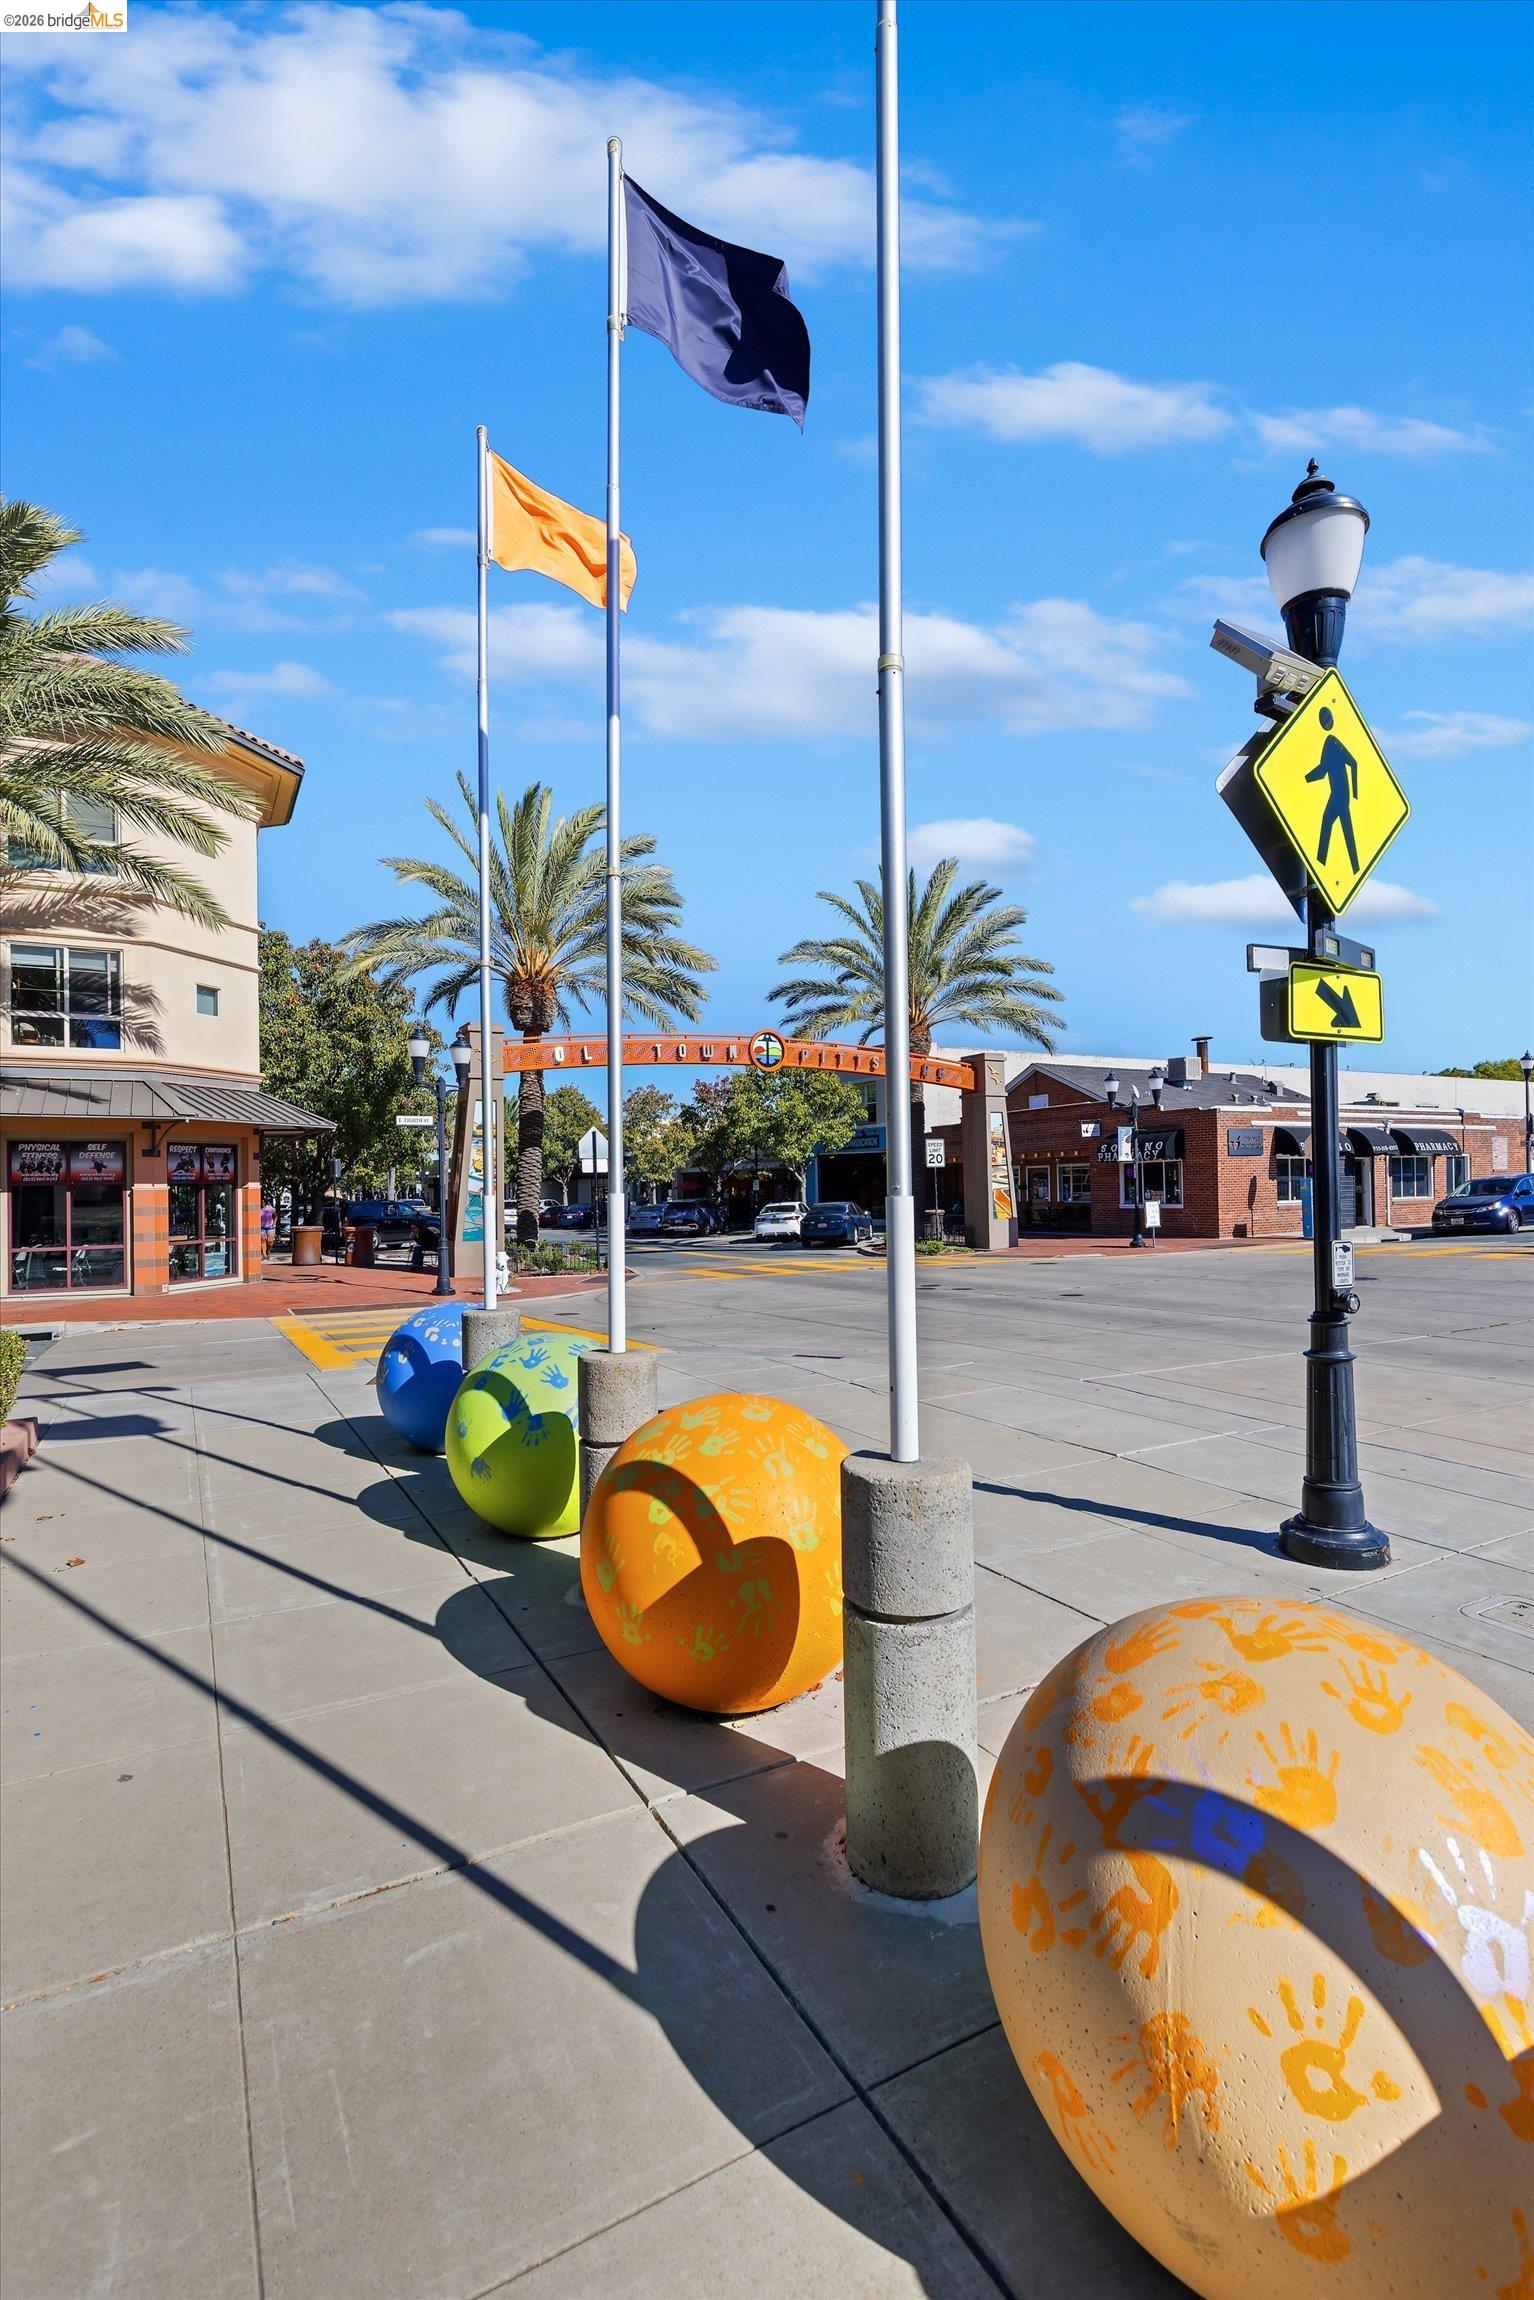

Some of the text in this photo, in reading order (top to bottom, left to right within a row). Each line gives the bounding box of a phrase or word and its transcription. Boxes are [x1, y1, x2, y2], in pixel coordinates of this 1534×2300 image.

[652, 1043, 738, 1060] TOWN
[799, 1048, 946, 1080] PITTSRG
[18, 1143, 60, 1151] PHYSICAL
[169, 1145, 198, 1153] RESPECT
[1101, 1141, 1163, 1151] SONO
[1414, 1142, 1460, 1151] PHARMACY
[21, 1152, 58, 1160] FITNESS
[79, 1151, 115, 1159] DEFENSE
[928, 1153, 943, 1164] 20
